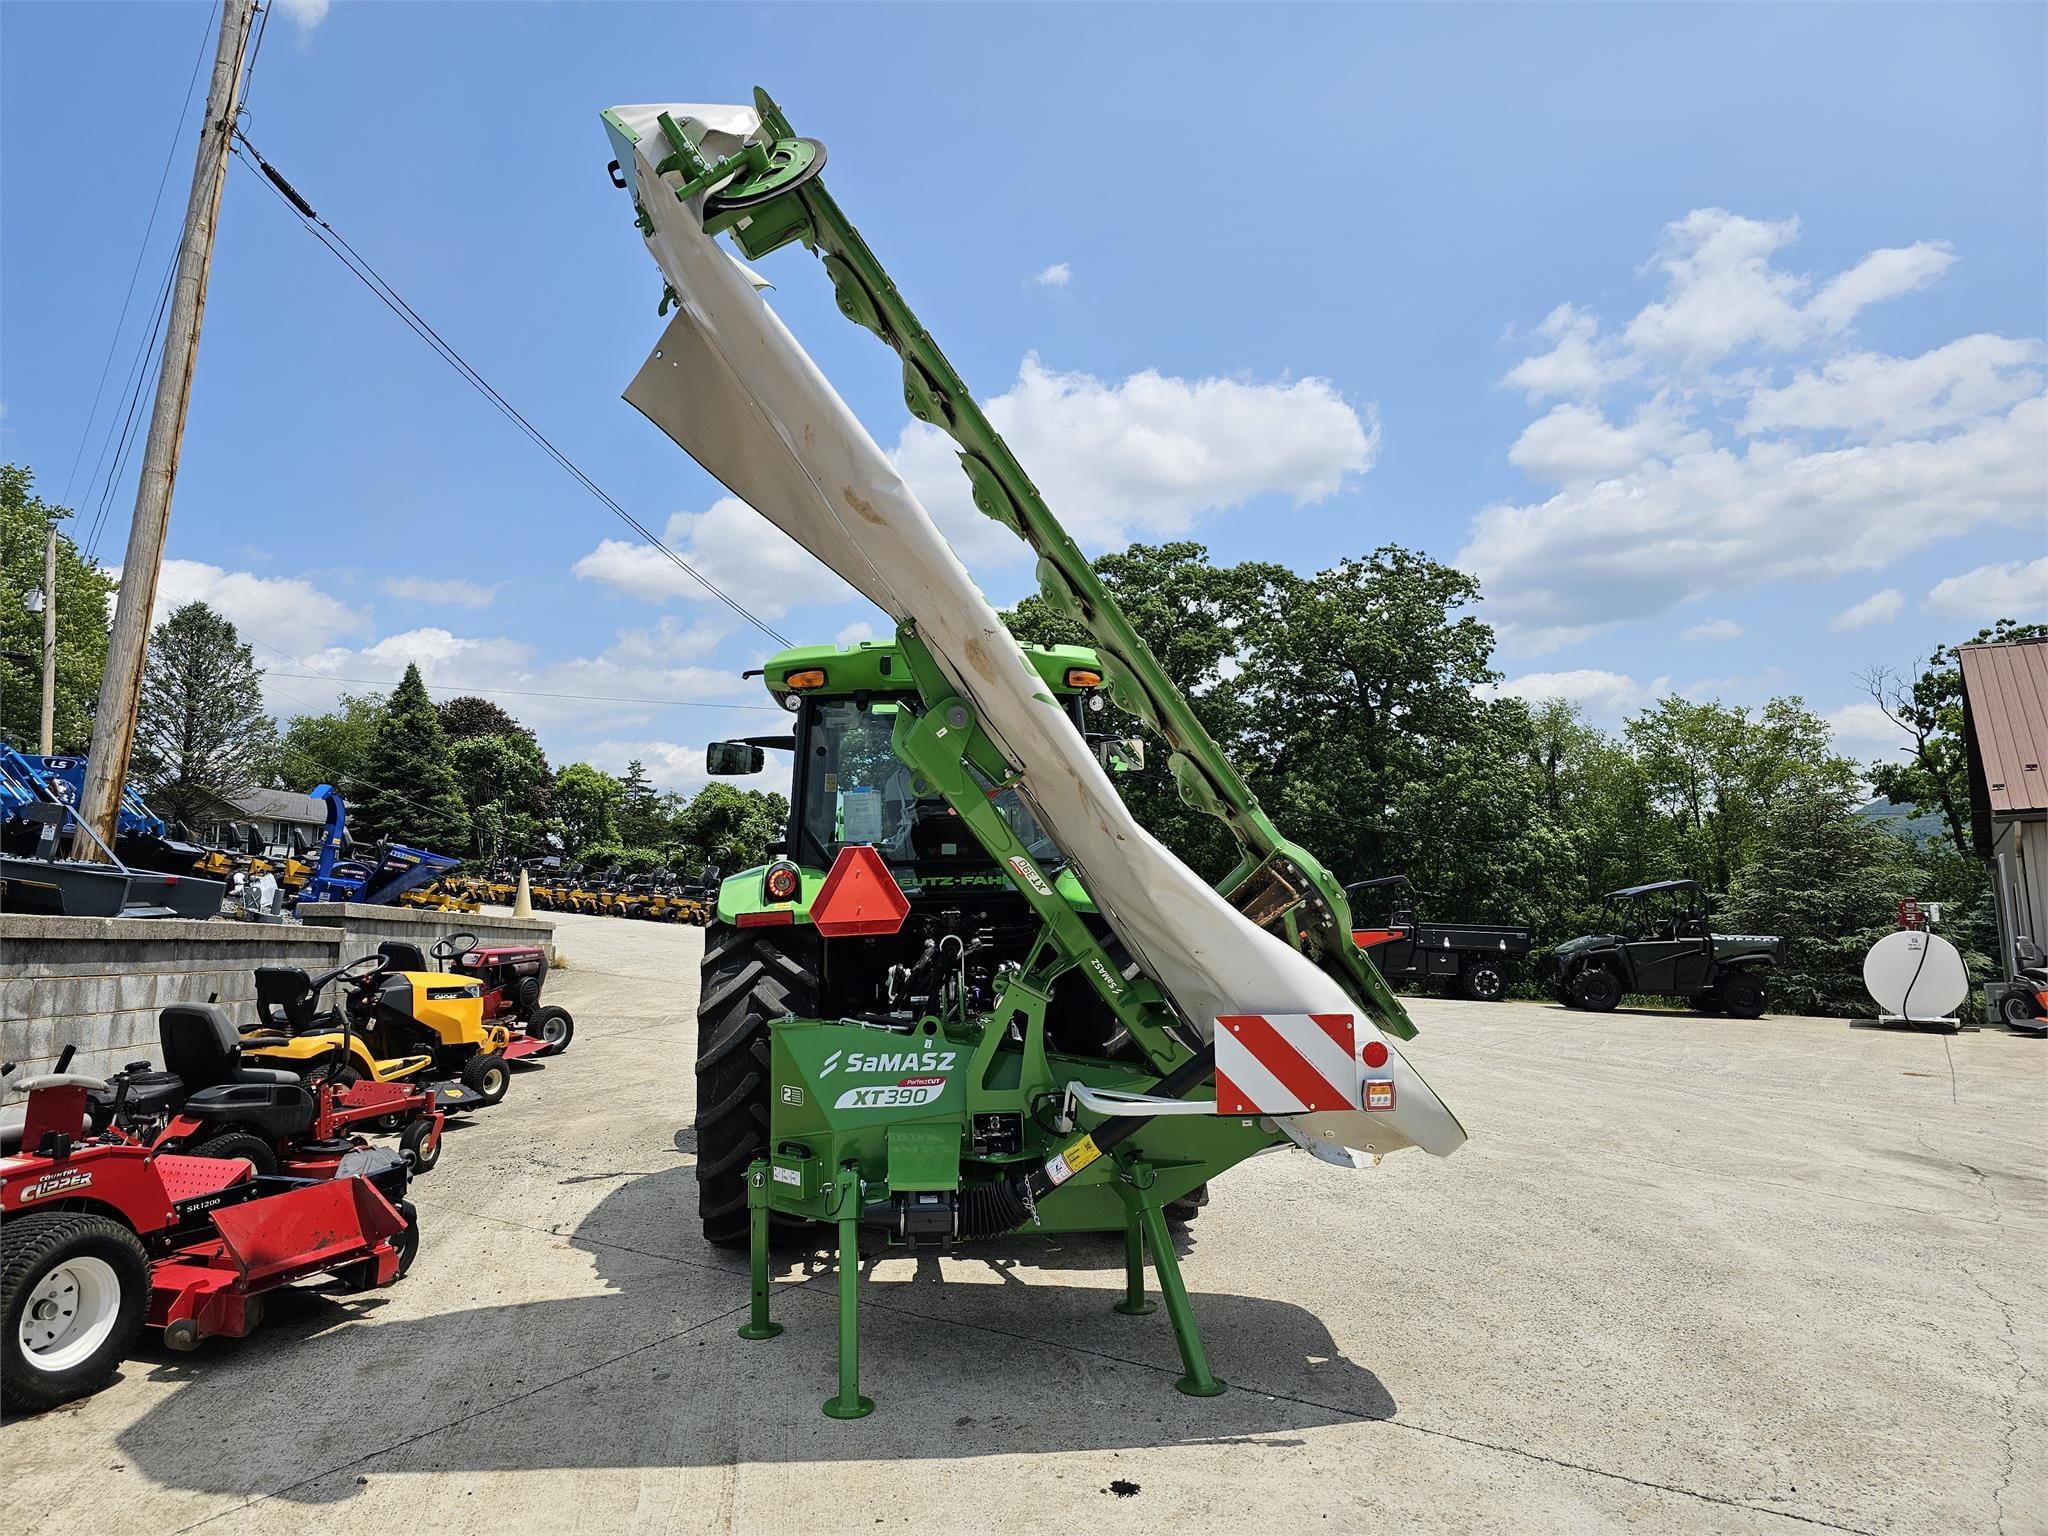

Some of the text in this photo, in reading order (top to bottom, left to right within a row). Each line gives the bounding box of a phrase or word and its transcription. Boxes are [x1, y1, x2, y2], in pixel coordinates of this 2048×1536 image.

[50, 760, 68, 769] LS
[897, 875, 1009, 887] EUTZ-FAH
[1017, 860, 1047, 891] XT390
[1091, 958, 1118, 989] SaMASZ
[845, 1052, 956, 1073] SaMASZ
[783, 1087, 792, 1102] 2
[852, 1088, 928, 1106] XT390
[39, 1168, 79, 1182] COUNTRY
[20, 1172, 93, 1203] CLIPPER
[186, 1198, 221, 1213] SR1200
